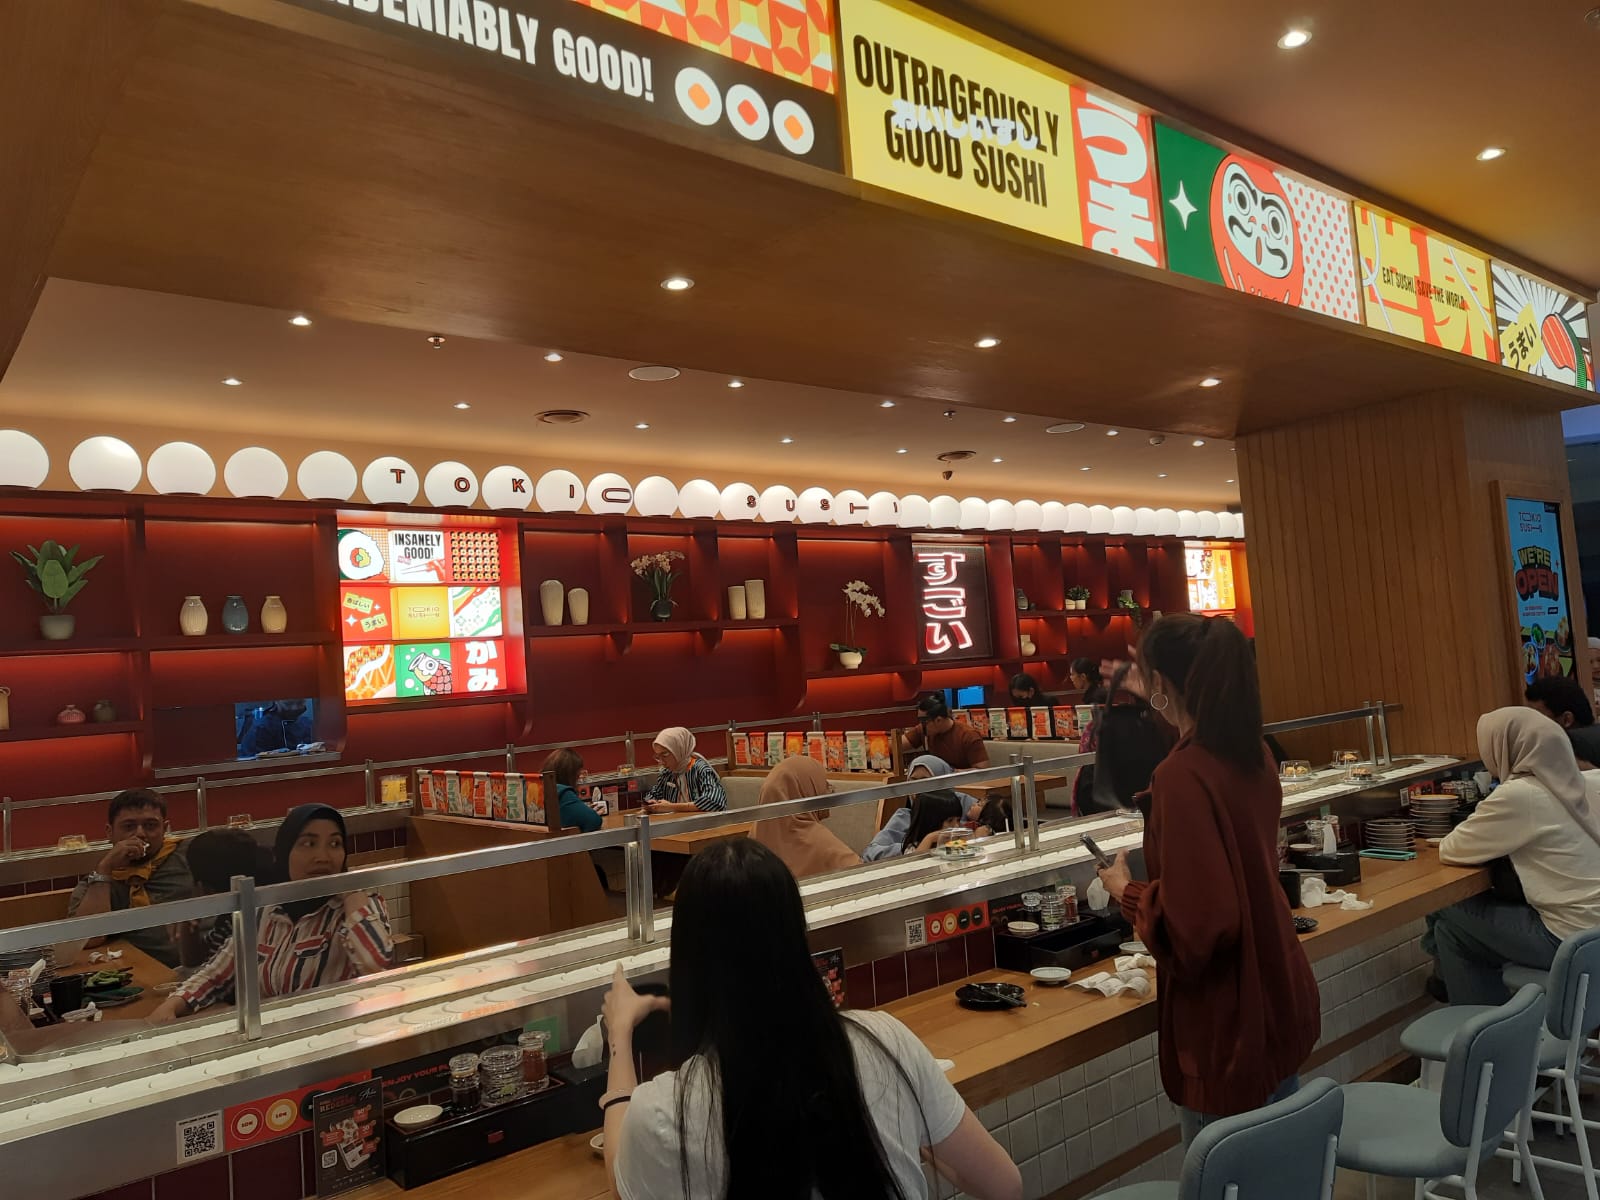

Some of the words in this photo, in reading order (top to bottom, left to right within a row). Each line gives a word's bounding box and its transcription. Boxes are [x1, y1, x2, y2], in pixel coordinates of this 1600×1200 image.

[333, 0, 538, 65] NIABLY
[553, 28, 655, 103] GOOD!
[853, 34, 1059, 157] OUTRAGEOUSLY
[884, 109, 963, 180] GOOD
[971, 140, 1048, 208] SUSHI
[1382, 266, 1394, 286] EAT
[1417, 279, 1433, 299] SAVE
[1433, 285, 1445, 303] THE
[1445, 289, 1466, 311] WORLD
[394, 533, 441, 547] INSANELY
[404, 546, 434, 560] GOOD!
[1516, 568, 1559, 600] OPEN
